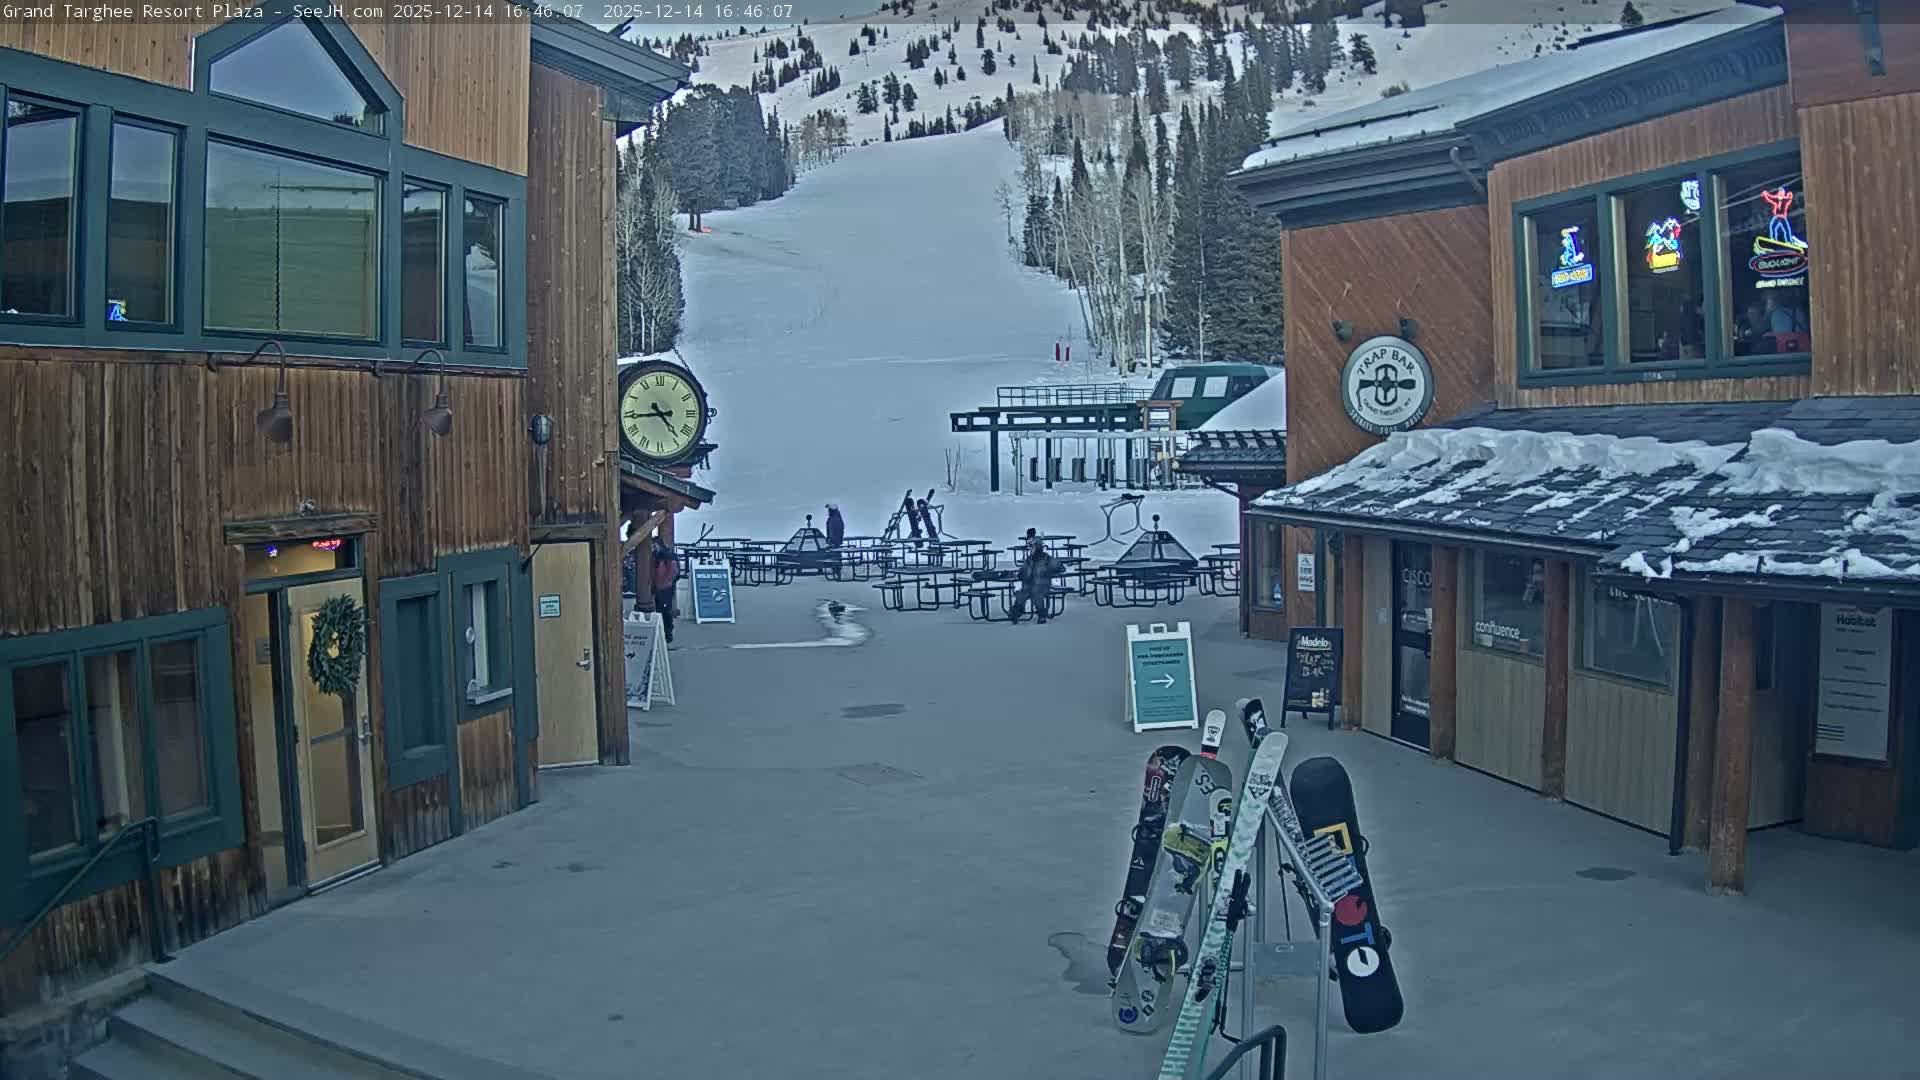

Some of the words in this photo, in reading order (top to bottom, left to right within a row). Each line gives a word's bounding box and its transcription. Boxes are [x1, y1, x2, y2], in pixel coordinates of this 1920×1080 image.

[1357, 348, 1388, 375] TRAP
[1391, 350, 1415, 375] BAR
[1401, 567, 1432, 586] CISCO
[1475, 620, 1520, 640] confluence
[1301, 635, 1329, 648] Modelo
